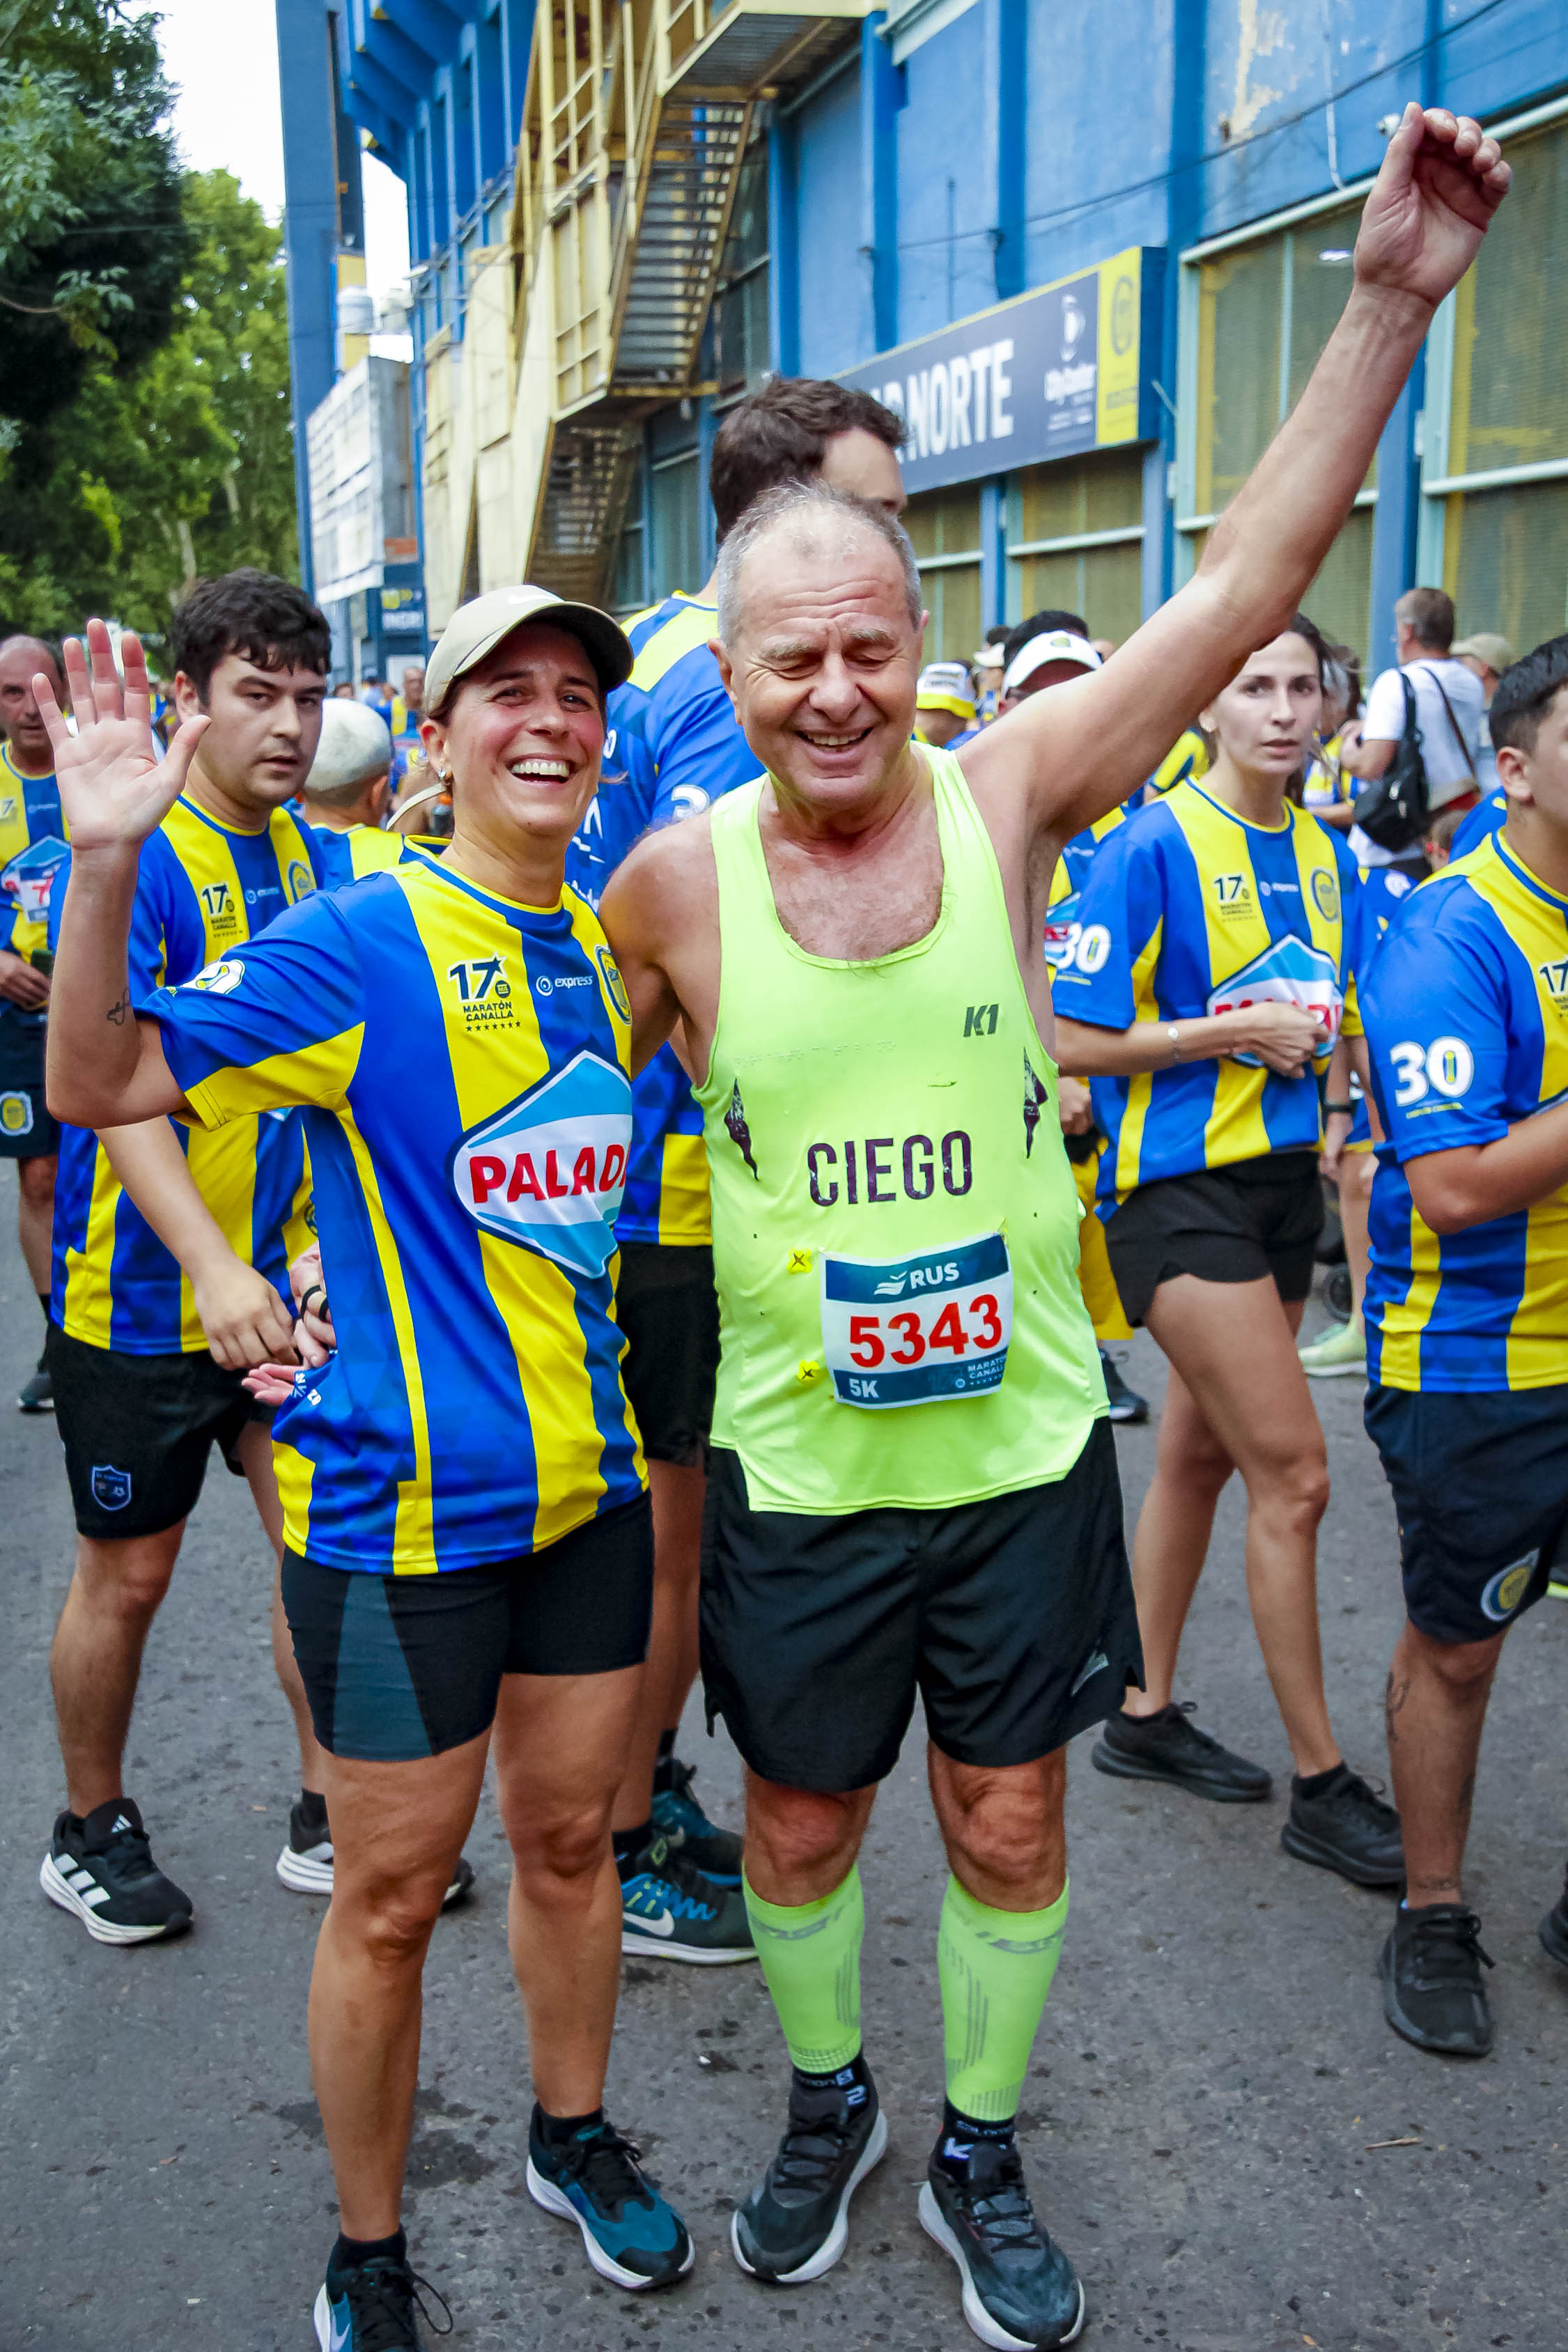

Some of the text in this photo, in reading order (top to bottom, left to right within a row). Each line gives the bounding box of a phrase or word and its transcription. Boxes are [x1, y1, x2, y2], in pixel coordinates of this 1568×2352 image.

[906, 338, 1014, 462] NORTE
[201, 883, 230, 915] 17
[1213, 874, 1243, 901] 17
[449, 955, 504, 1002] 17
[554, 975, 593, 989] express
[463, 1000, 512, 1014] MARATÓN
[466, 1009, 514, 1022] CANALLA
[963, 1003, 999, 1037] K1
[1390, 1036, 1475, 1108] 30
[807, 1130, 972, 1207] CIEGO
[910, 1262, 960, 1290] RUS
[849, 1293, 1003, 1368] 5343
[848, 1377, 880, 1399] 5K
